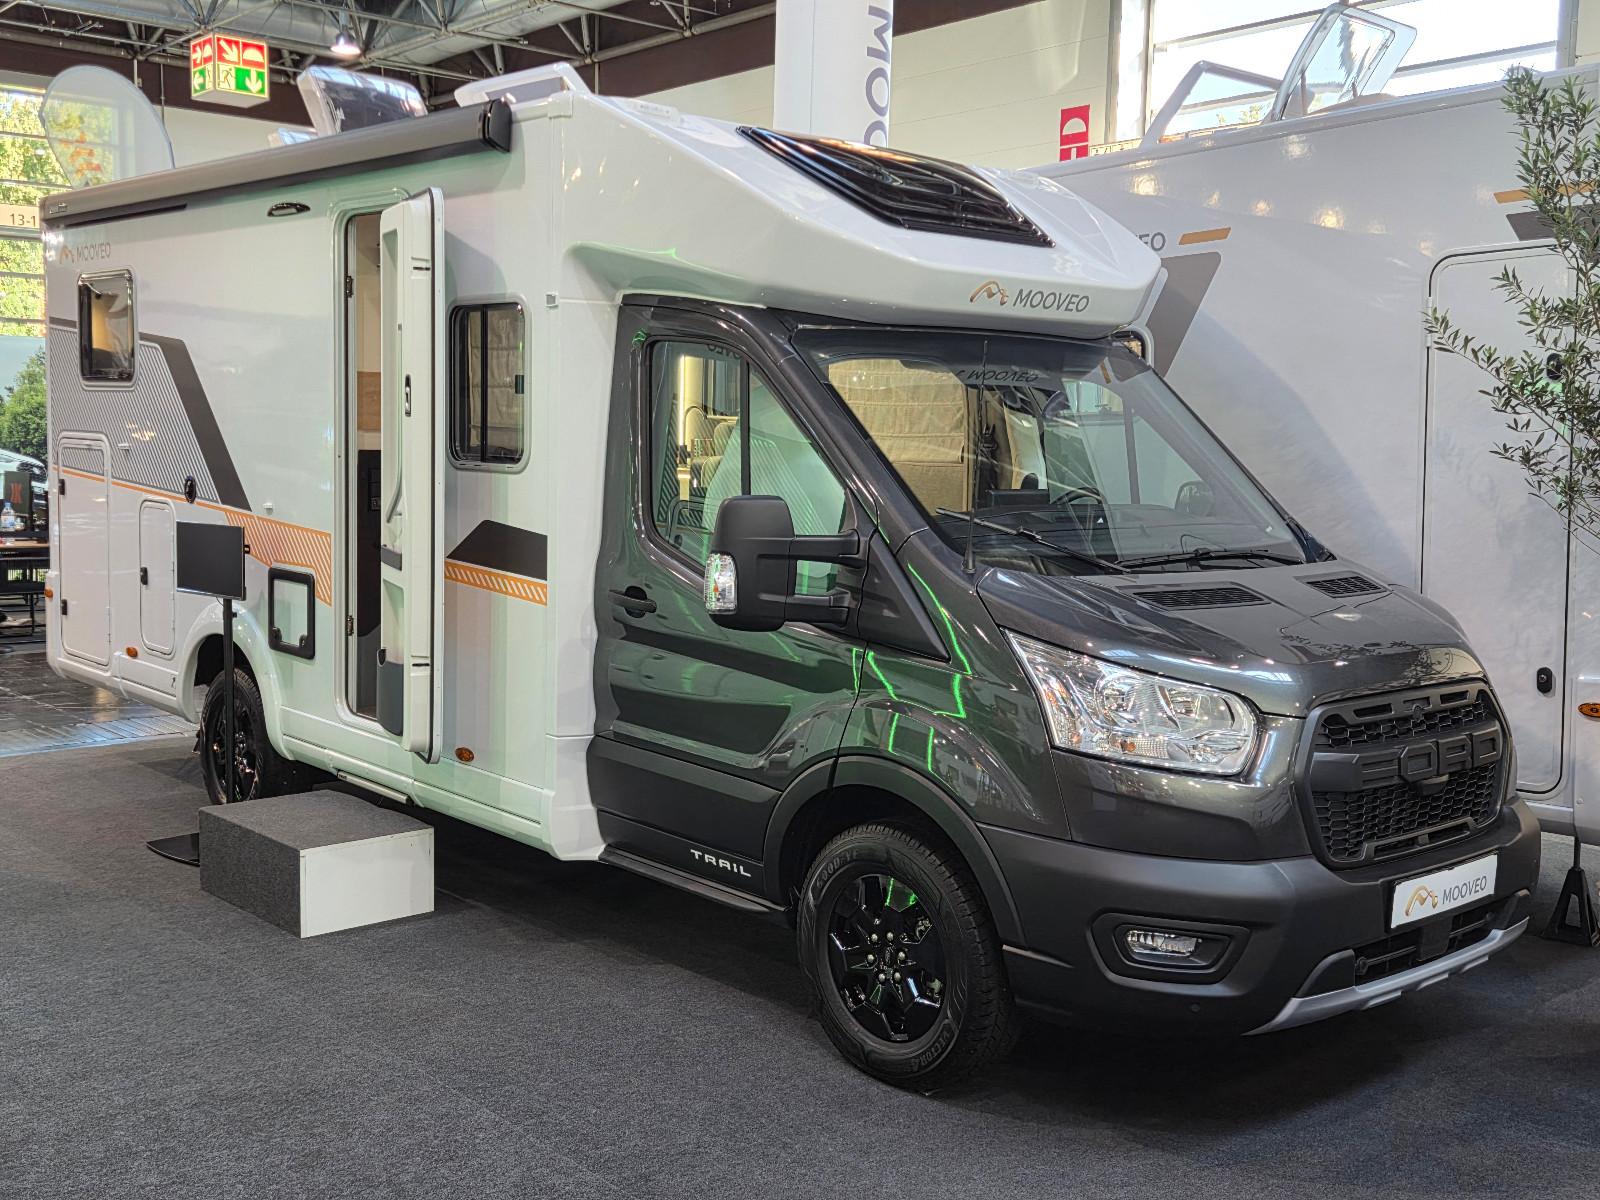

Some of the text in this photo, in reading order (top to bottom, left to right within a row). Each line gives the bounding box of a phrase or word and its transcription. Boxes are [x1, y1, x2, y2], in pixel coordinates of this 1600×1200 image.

[9, 213, 36, 227] 13-1
[76, 242, 111, 262] MOOVEO
[1012, 288, 1090, 312] MOOVEO
[1354, 726, 1502, 791] FORD
[690, 849, 752, 878] TRAIL
[1442, 875, 1488, 905] MOOVEO
